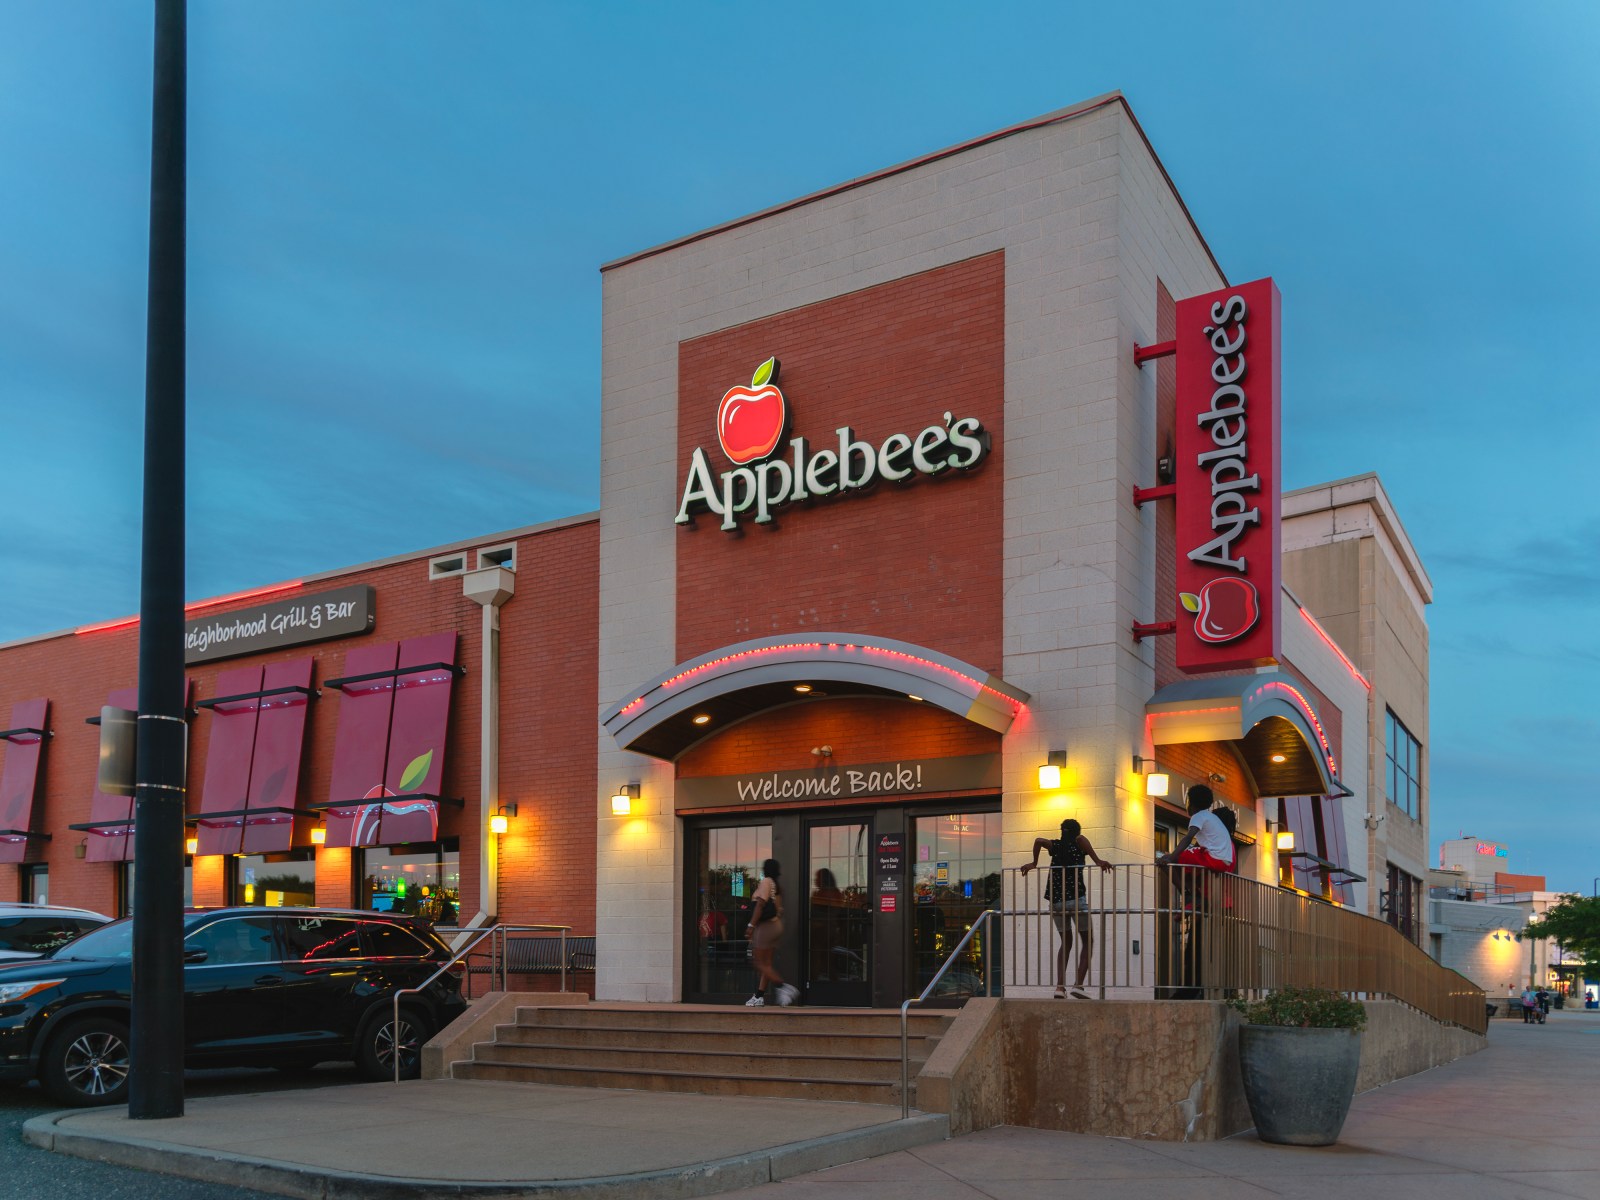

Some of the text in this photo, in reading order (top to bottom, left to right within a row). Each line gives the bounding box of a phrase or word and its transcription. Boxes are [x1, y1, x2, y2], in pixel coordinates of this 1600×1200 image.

[674, 410, 984, 532] Applebee's
[1187, 294, 1261, 573] Applebee's
[184, 600, 357, 652] eighborhood Grill & Bar
[737, 763, 922, 801] Welcome Back!
